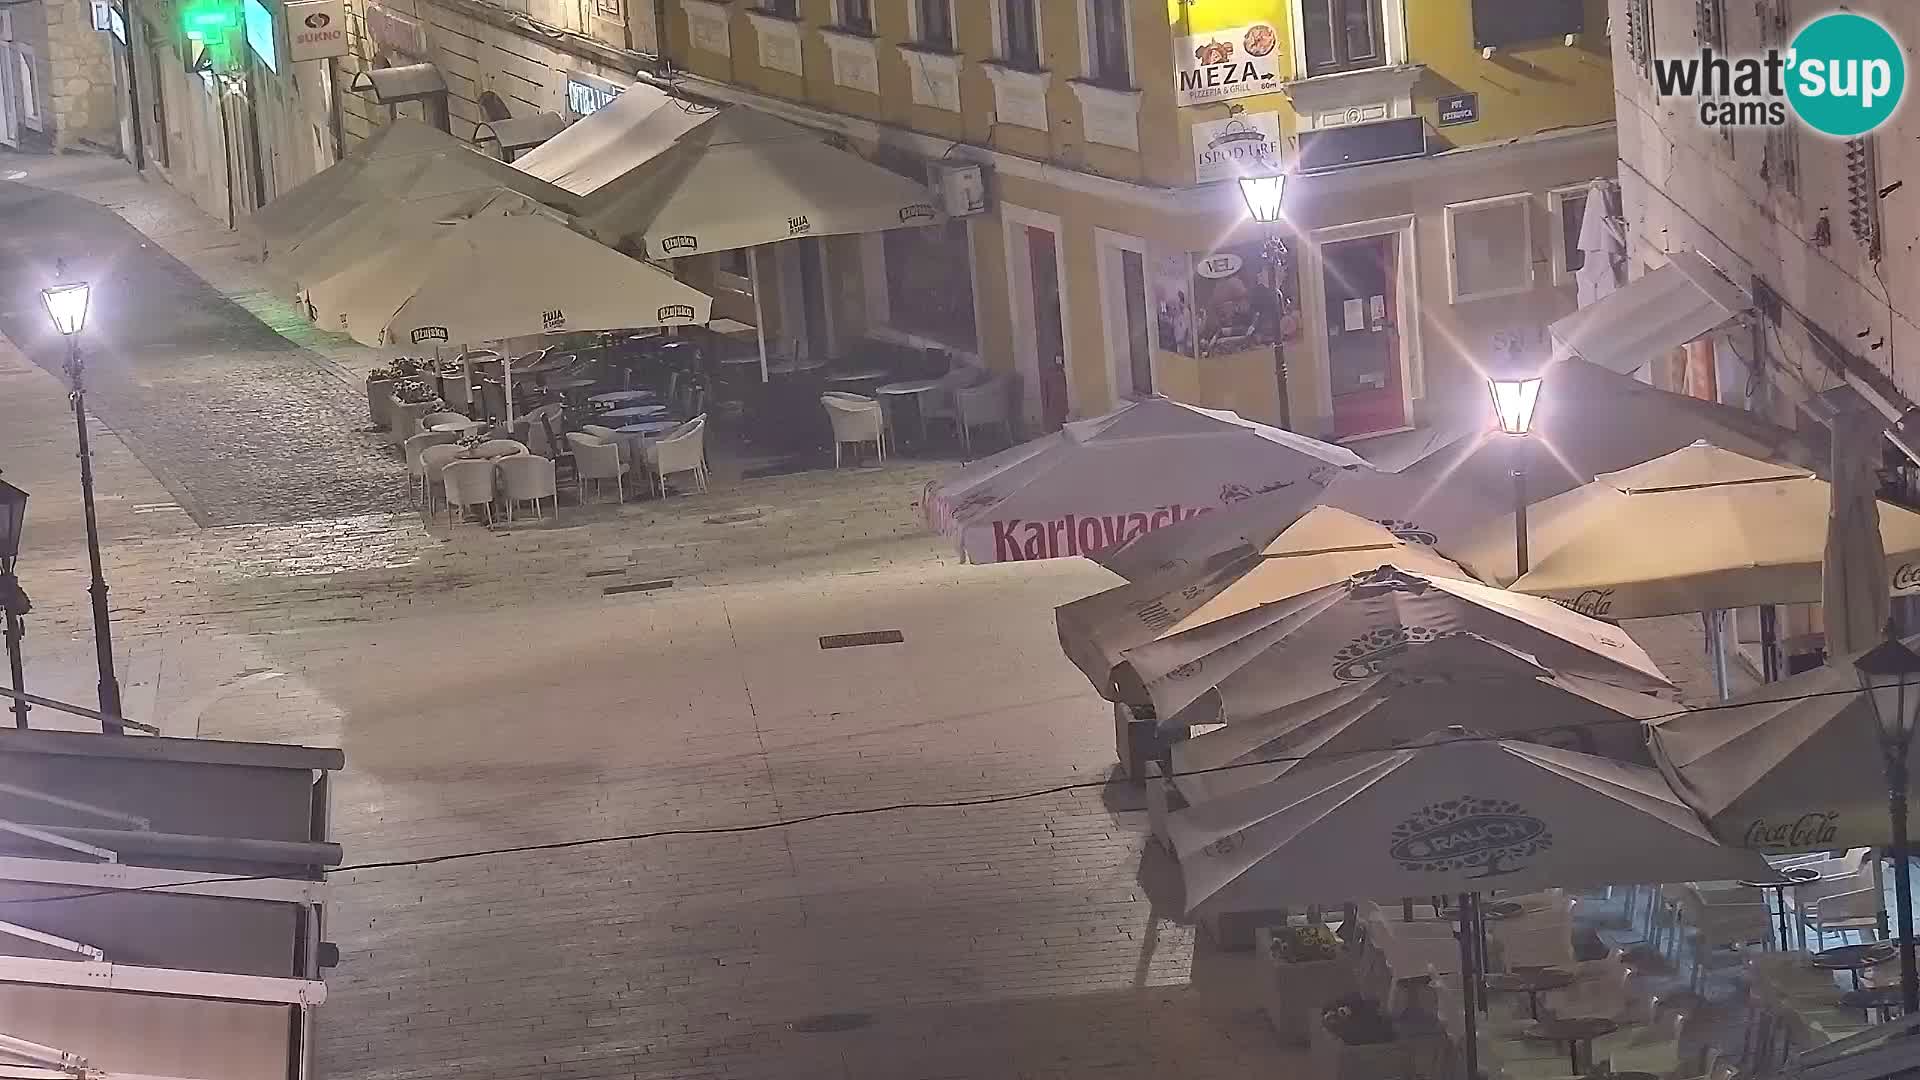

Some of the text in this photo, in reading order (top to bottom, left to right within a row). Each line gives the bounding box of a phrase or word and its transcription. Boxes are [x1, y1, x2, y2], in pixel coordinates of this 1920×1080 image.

[296, 30, 341, 44] SUKNO
[1180, 61, 1259, 92] MEZA
[1189, 88, 1221, 99] PIZZERIA
[1230, 83, 1251, 93] GRILL
[1199, 146, 1244, 165] ISPOD
[787, 216, 808, 230] ŽUJA
[542, 310, 564, 323] ŽUJA
[413, 327, 446, 343] Ožujsko
[1431, 822, 1532, 850] RAUCH
